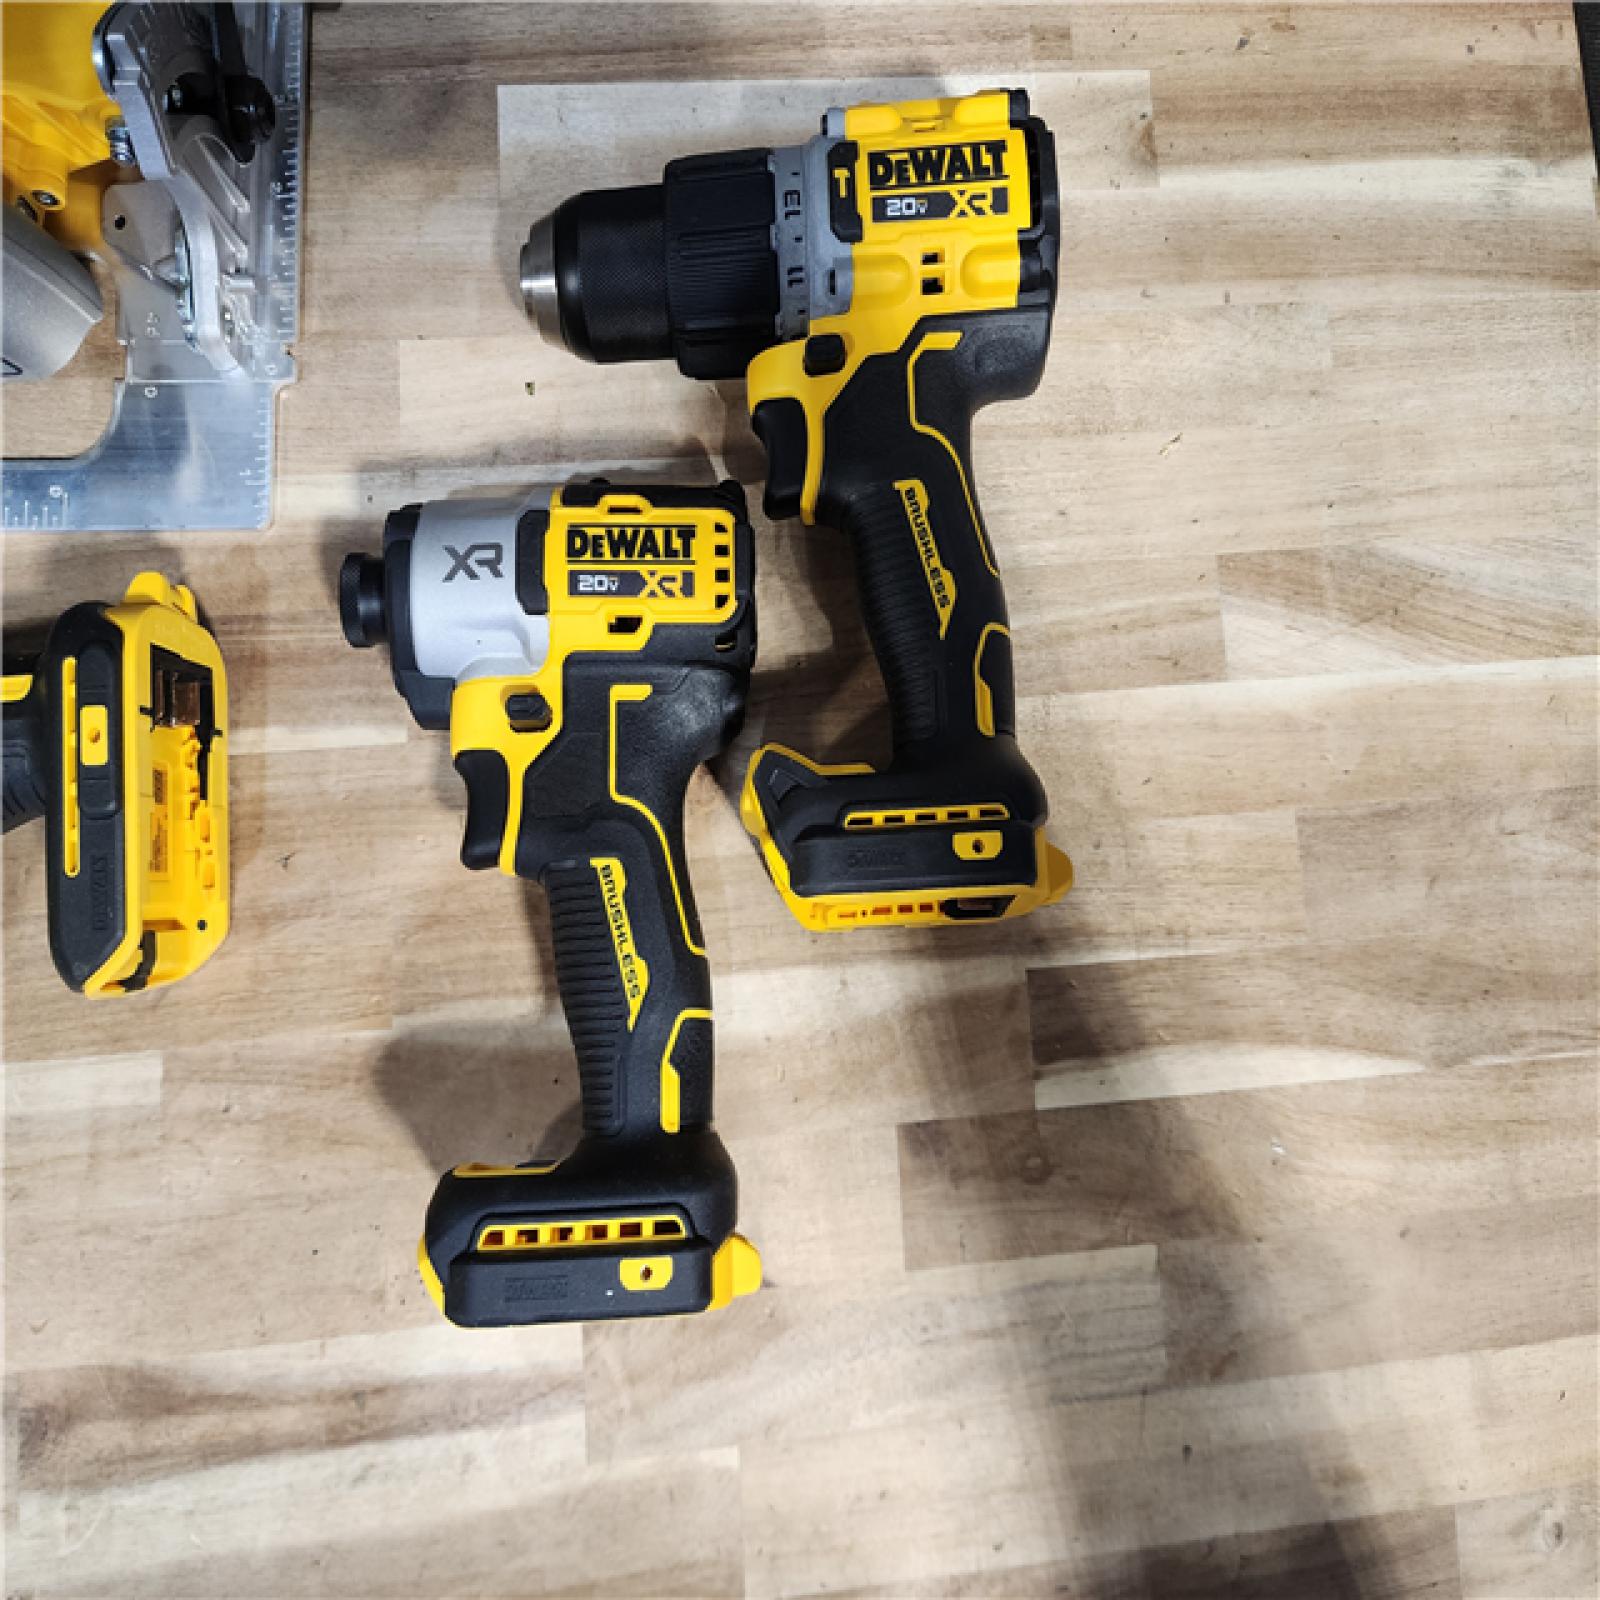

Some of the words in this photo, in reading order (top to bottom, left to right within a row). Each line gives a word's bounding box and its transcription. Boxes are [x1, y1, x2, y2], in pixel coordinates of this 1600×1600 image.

[442, 543, 504, 583] XR
[567, 529, 696, 558] DEWALT
[905, 487, 950, 608] BRUSHLESS
[638, 570, 684, 598] XR
[602, 865, 641, 998] BRUSHLESS
